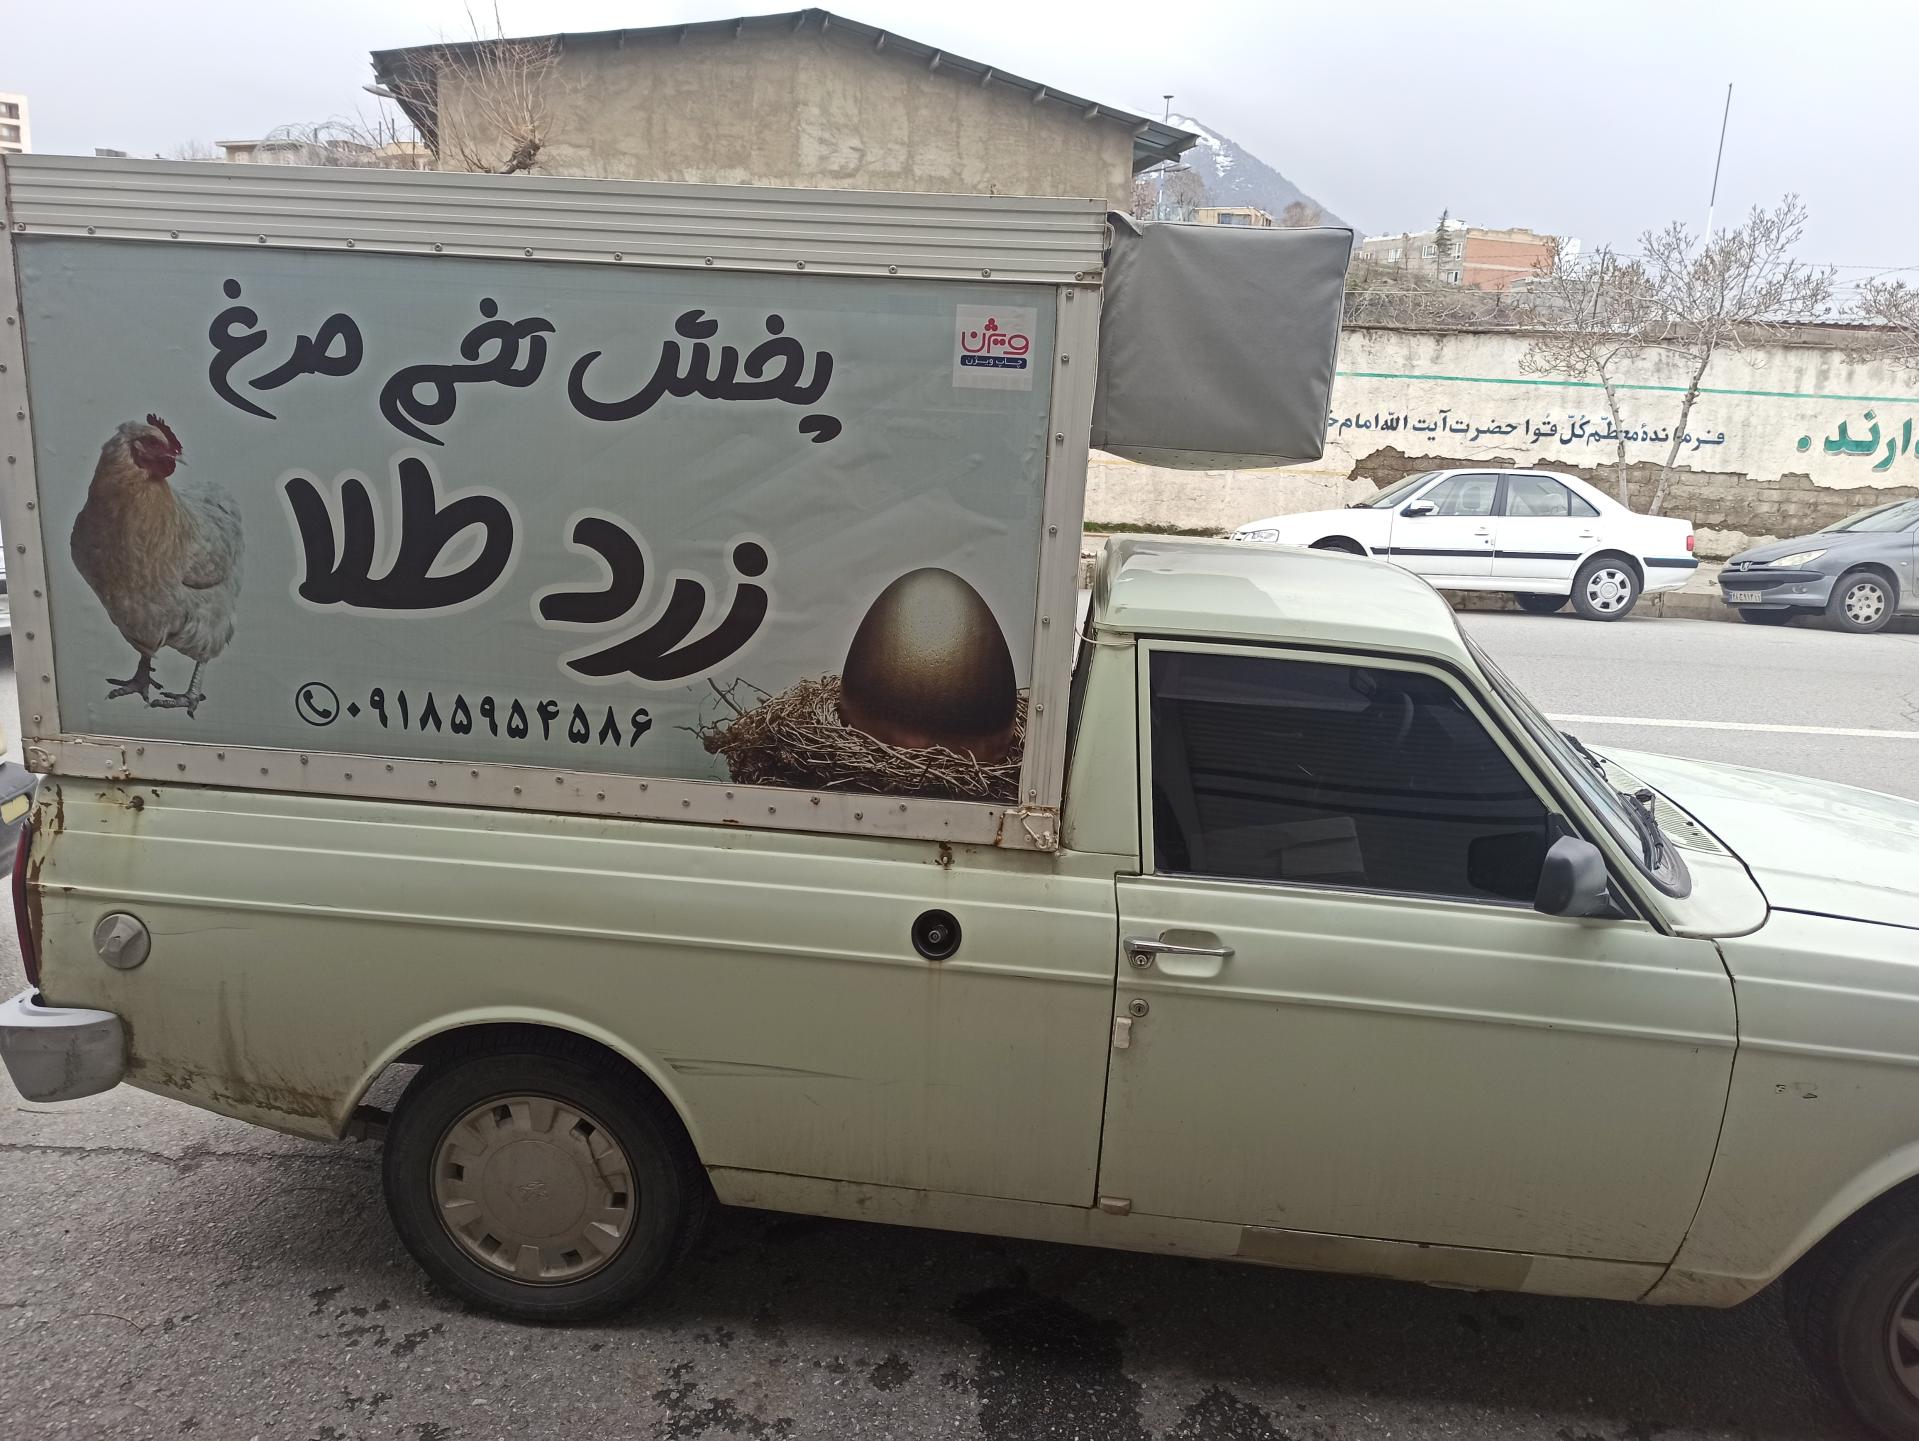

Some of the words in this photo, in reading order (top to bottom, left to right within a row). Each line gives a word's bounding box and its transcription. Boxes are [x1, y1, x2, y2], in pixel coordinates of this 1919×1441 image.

[208, 278, 364, 420] مرغ
[379, 297, 556, 446] تخم
[567, 309, 842, 443] پخش
[995, 357, 1023, 368] چاپ
[1339, 412, 1379, 437] امام
[1449, 418, 1518, 442] حضرت
[284, 456, 514, 610] طلا
[538, 516, 769, 682] زرد
[345, 686, 653, 748] ۰۹۱۸۵۹۵۴۵۸۶
